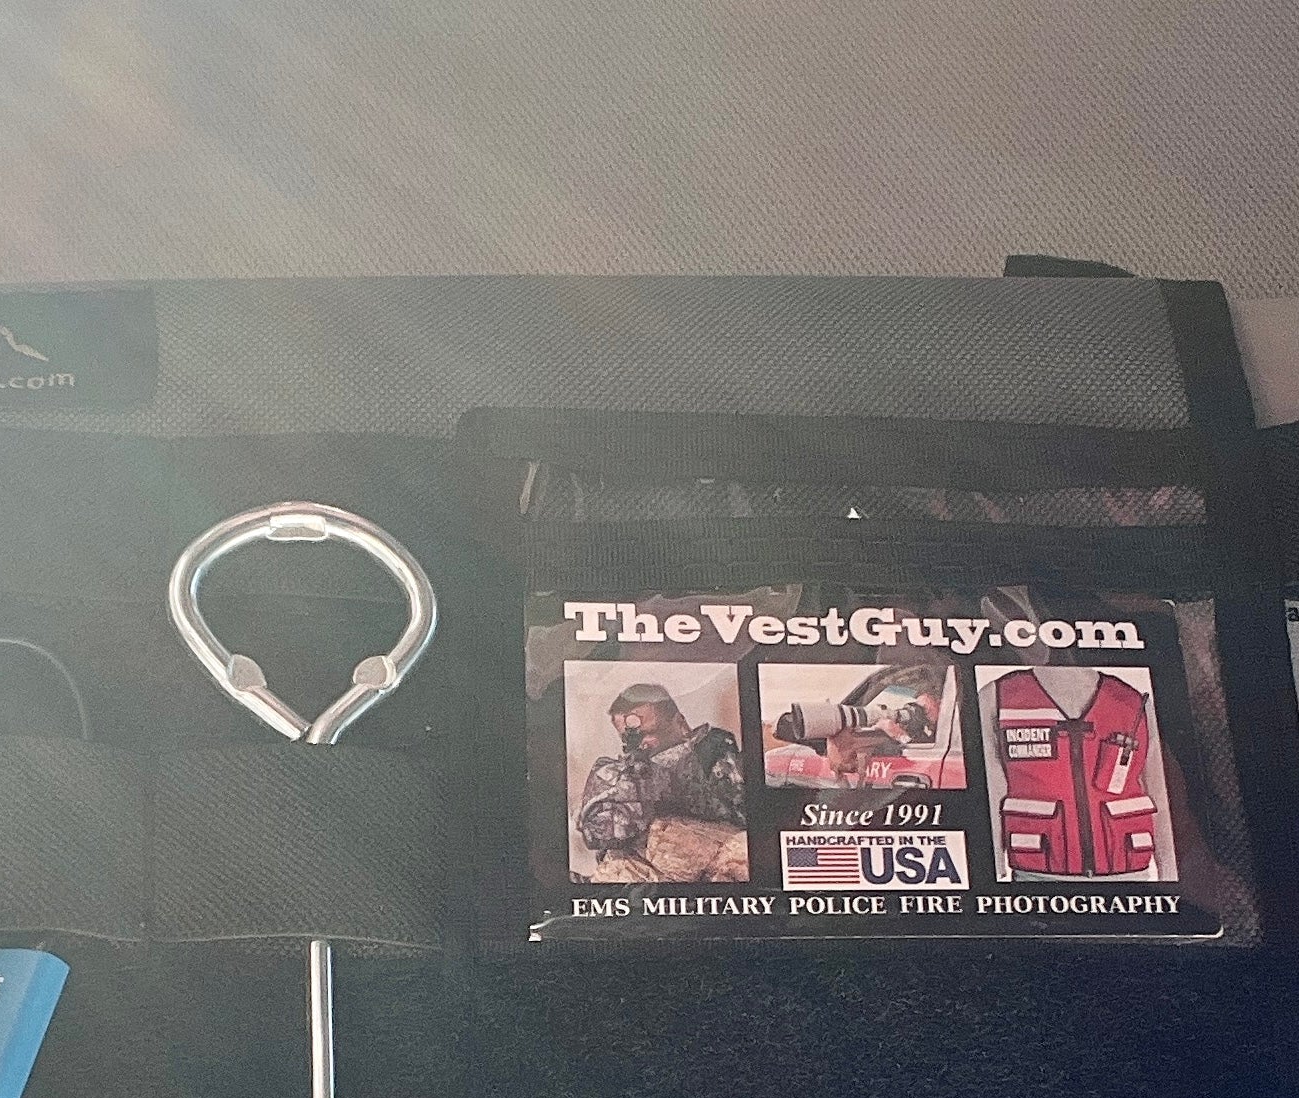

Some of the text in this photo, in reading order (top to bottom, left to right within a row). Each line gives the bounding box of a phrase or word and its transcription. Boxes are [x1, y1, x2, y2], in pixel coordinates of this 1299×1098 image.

[563, 601, 1146, 655] TheVestGuy.com
[801, 803, 944, 827] Since 1991
[785, 835, 947, 846] HANDCRAFTED IN THE
[860, 846, 962, 886] USA
[571, 895, 1182, 917] EMS MILITARY POLICE FIRE PHOTOGRAPHY
